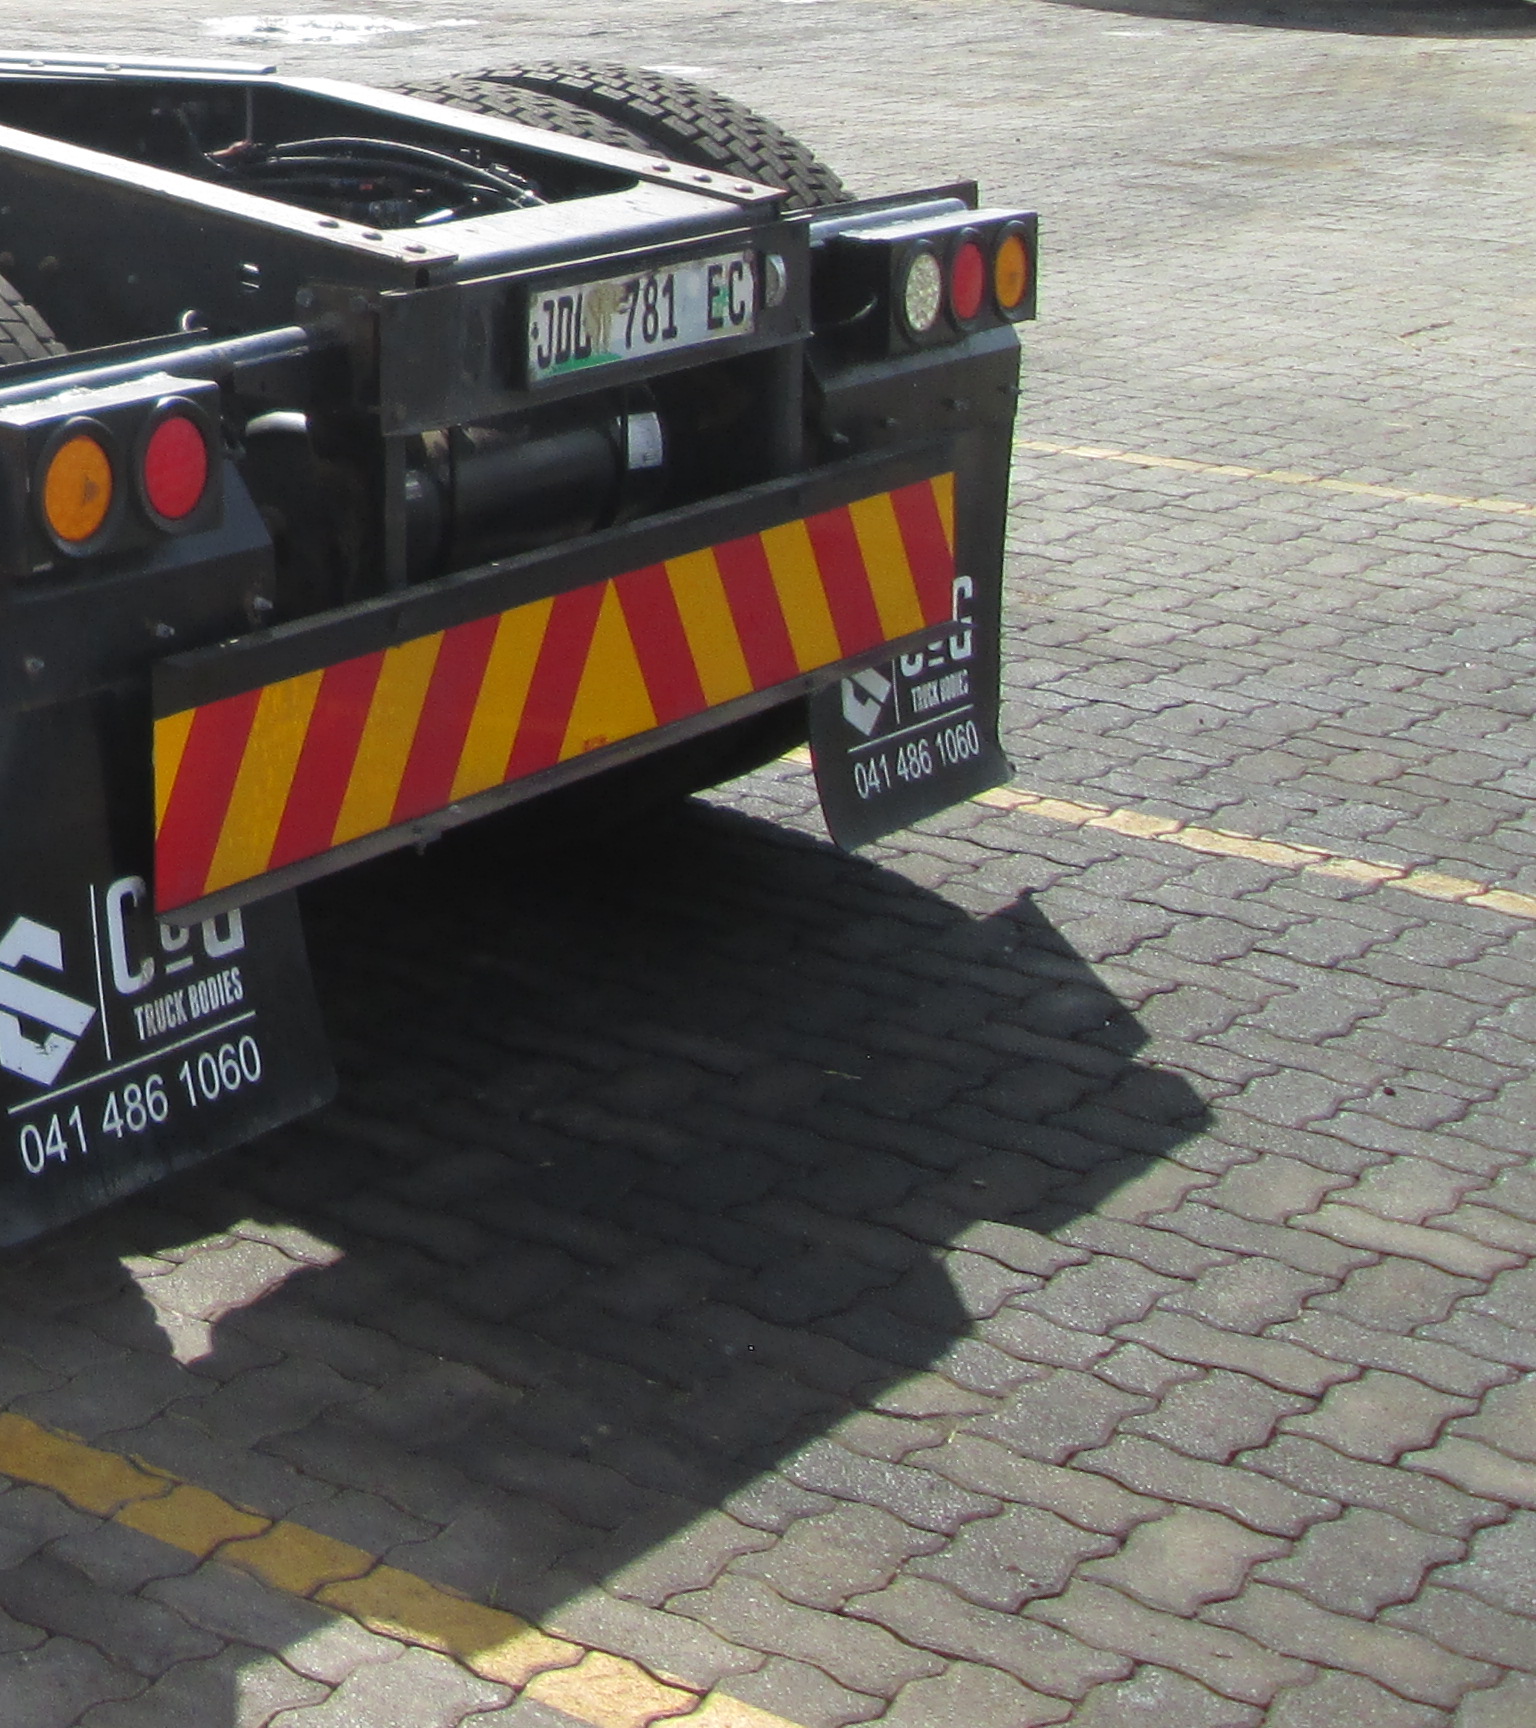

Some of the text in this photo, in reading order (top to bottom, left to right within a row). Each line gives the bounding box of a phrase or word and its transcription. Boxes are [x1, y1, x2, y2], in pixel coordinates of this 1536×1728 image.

[537, 260, 746, 369] JDL 781 EC
[854, 720, 980, 799] 041 486 1060
[133, 967, 244, 1040] TRUCK BODIES
[20, 1036, 262, 1173] 041 486 1060
